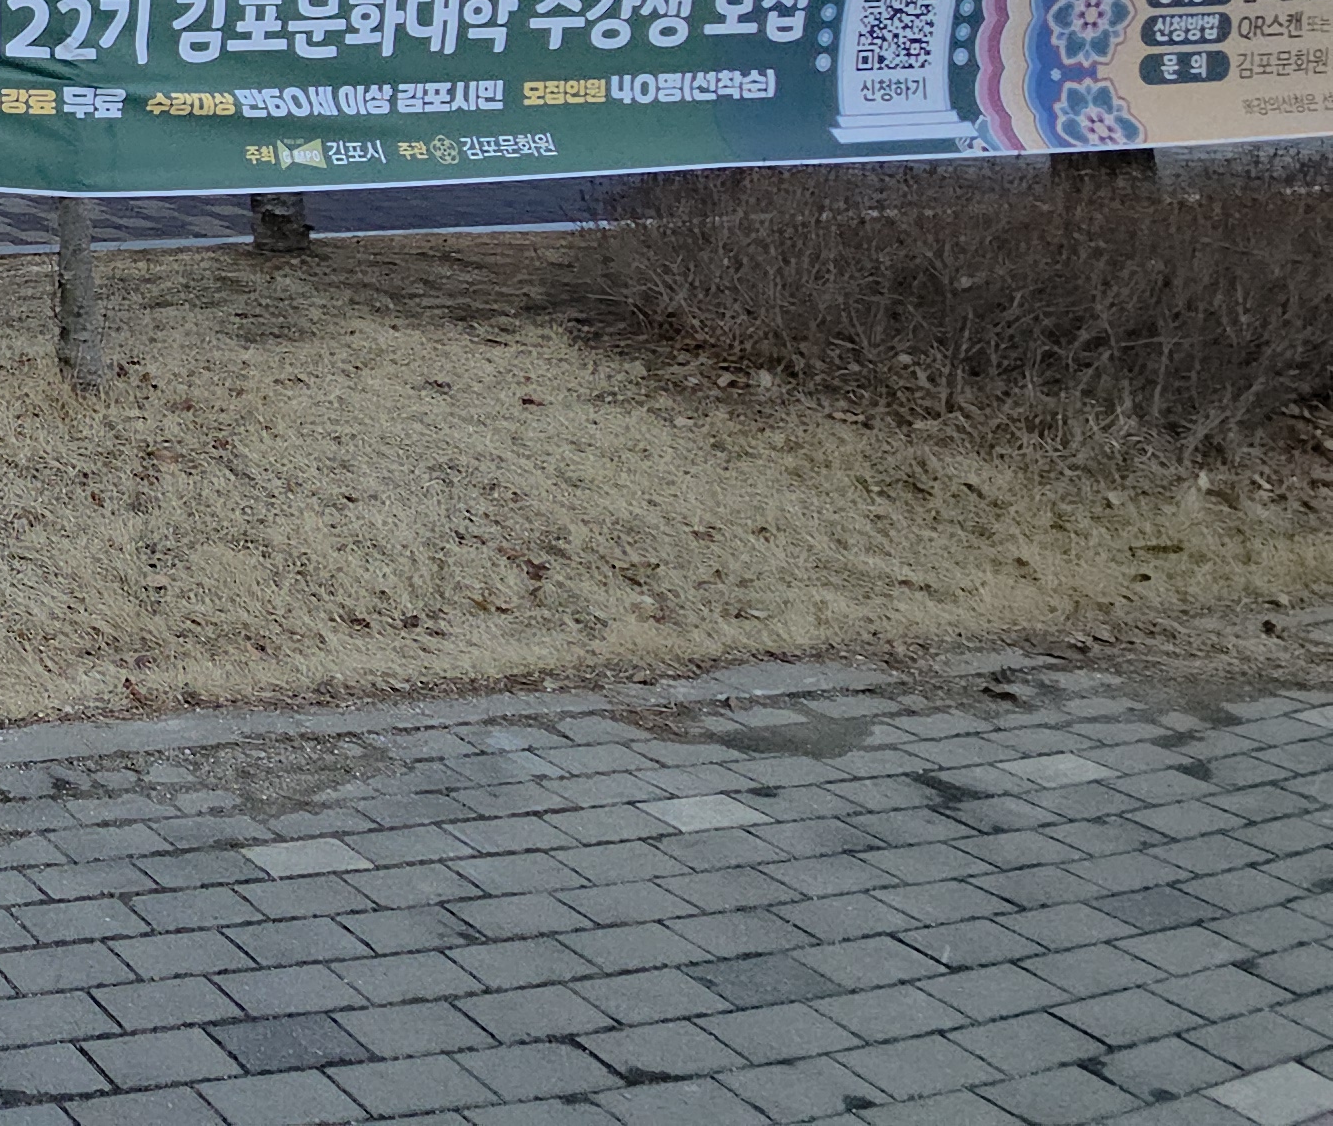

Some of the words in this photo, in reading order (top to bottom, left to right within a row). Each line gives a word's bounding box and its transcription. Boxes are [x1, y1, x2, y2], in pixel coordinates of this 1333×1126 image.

[1153, 14, 1220, 42] 신청방법
[1237, 10, 1304, 41] QR스캔
[1236, 47, 1329, 80] 김포문화원
[62, 87, 126, 119] 무료
[145, 90, 236, 116] 수강대상
[234, 85, 339, 119] 만60세
[338, 84, 394, 116] 이상
[396, 79, 505, 114] 김포시민
[523, 78, 607, 107] 모집인원
[610, 68, 775, 105] 40명(선착순)
[860, 76, 928, 102] 신청하기
[245, 145, 276, 166] 주최
[326, 139, 387, 166] 김포시
[397, 141, 430, 161] 주관
[459, 132, 559, 161] 김포문화원
